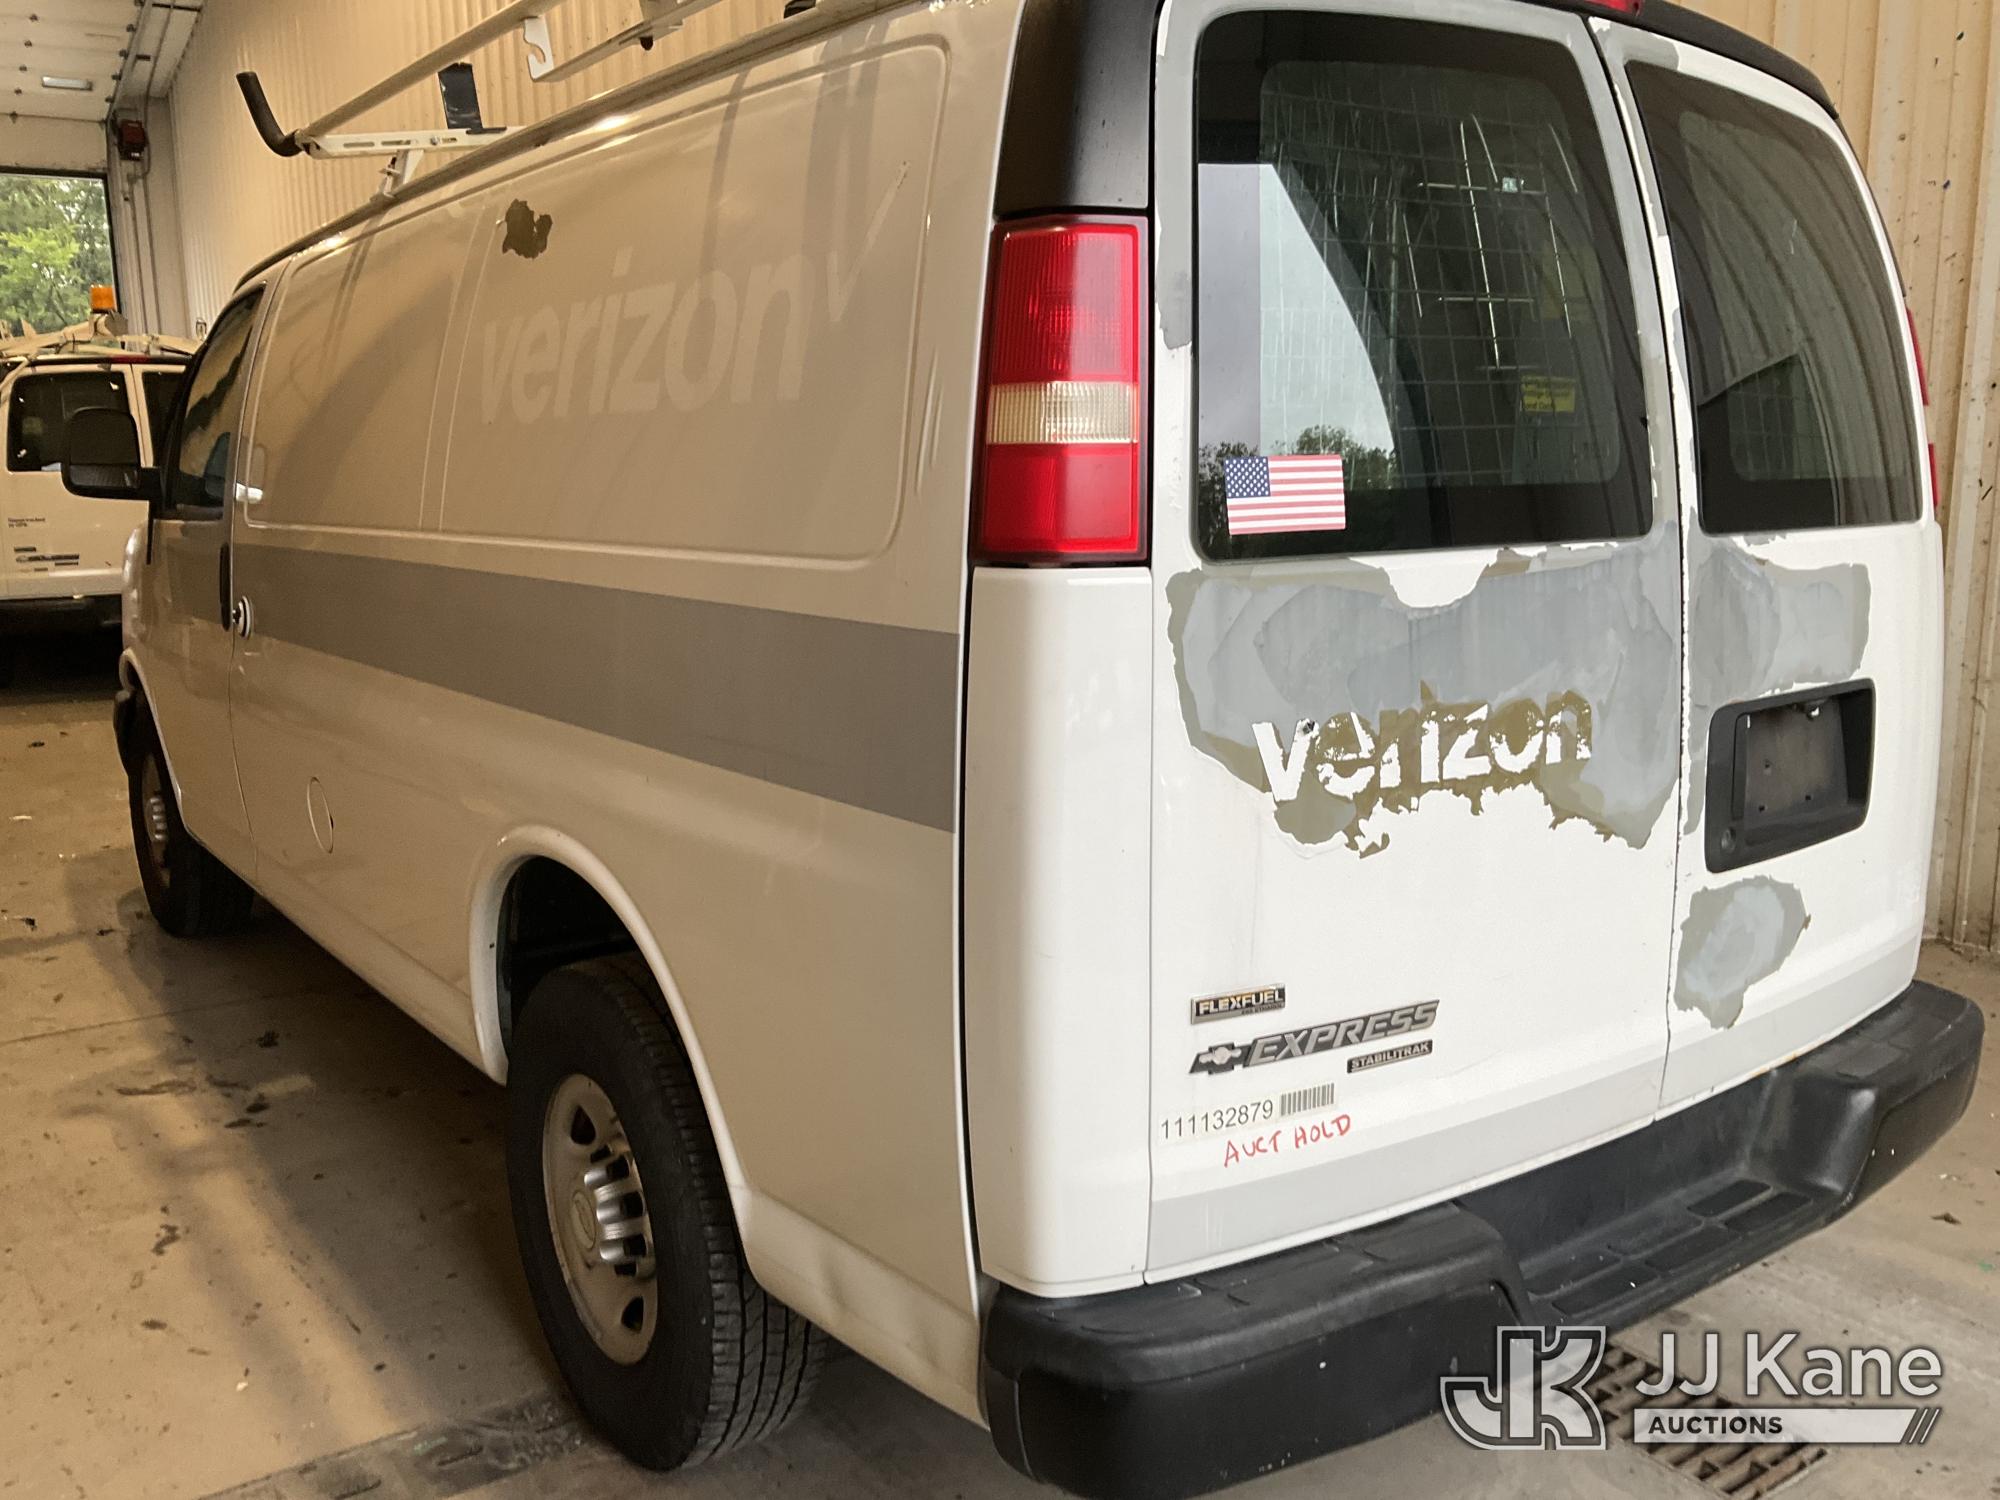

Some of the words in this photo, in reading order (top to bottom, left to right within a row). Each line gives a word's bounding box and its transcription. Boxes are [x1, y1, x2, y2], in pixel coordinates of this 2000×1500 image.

[480, 246, 817, 425] verizon
[1198, 988, 1284, 1015] FLEXFUEL
[1249, 1002, 1438, 1067] EXPRESS
[1351, 1042, 1430, 1069] STABILITRAK
[1161, 1099, 1274, 1139] 111132879
[1223, 1130, 1283, 1168] AUCT
[1294, 1114, 1351, 1149] HOLD
